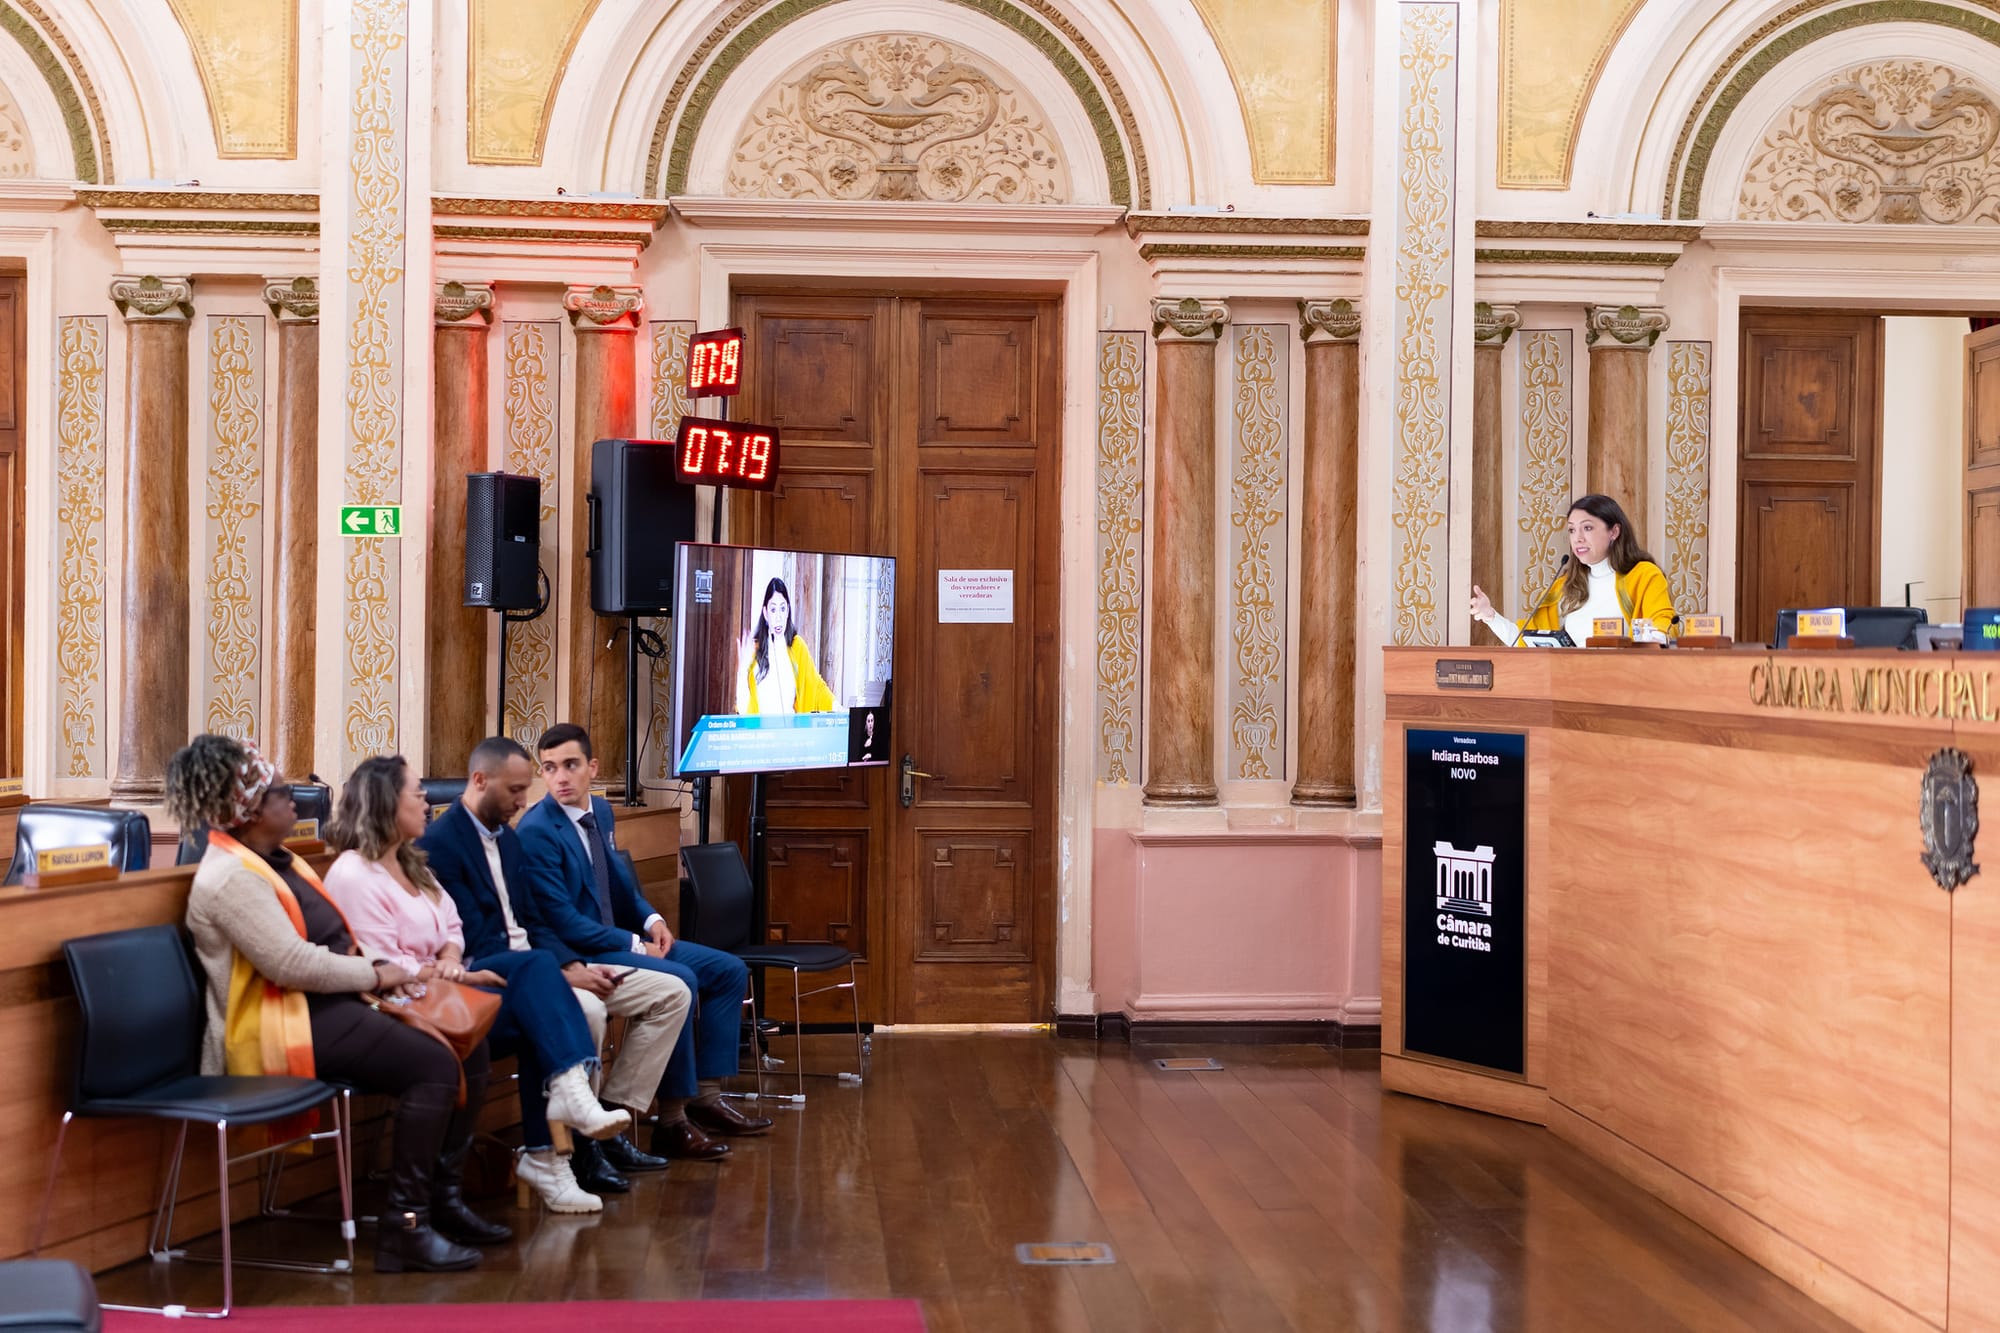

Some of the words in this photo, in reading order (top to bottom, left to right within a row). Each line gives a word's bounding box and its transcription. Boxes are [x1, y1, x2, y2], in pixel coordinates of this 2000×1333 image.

[683, 426, 771, 480] 07:19
[1750, 656, 1845, 713] CÂMARA
[1851, 667, 1999, 722] MUNICIPAL
[1453, 736, 1477, 745] Vereadora
[1432, 749, 1461, 763] Indiara
[1462, 751, 1499, 765] Barbosa
[1451, 767, 1477, 780] NOVO
[1436, 913, 1492, 937] Câmara
[1437, 933, 1450, 945] de
[1451, 934, 1491, 952] Curitiba
